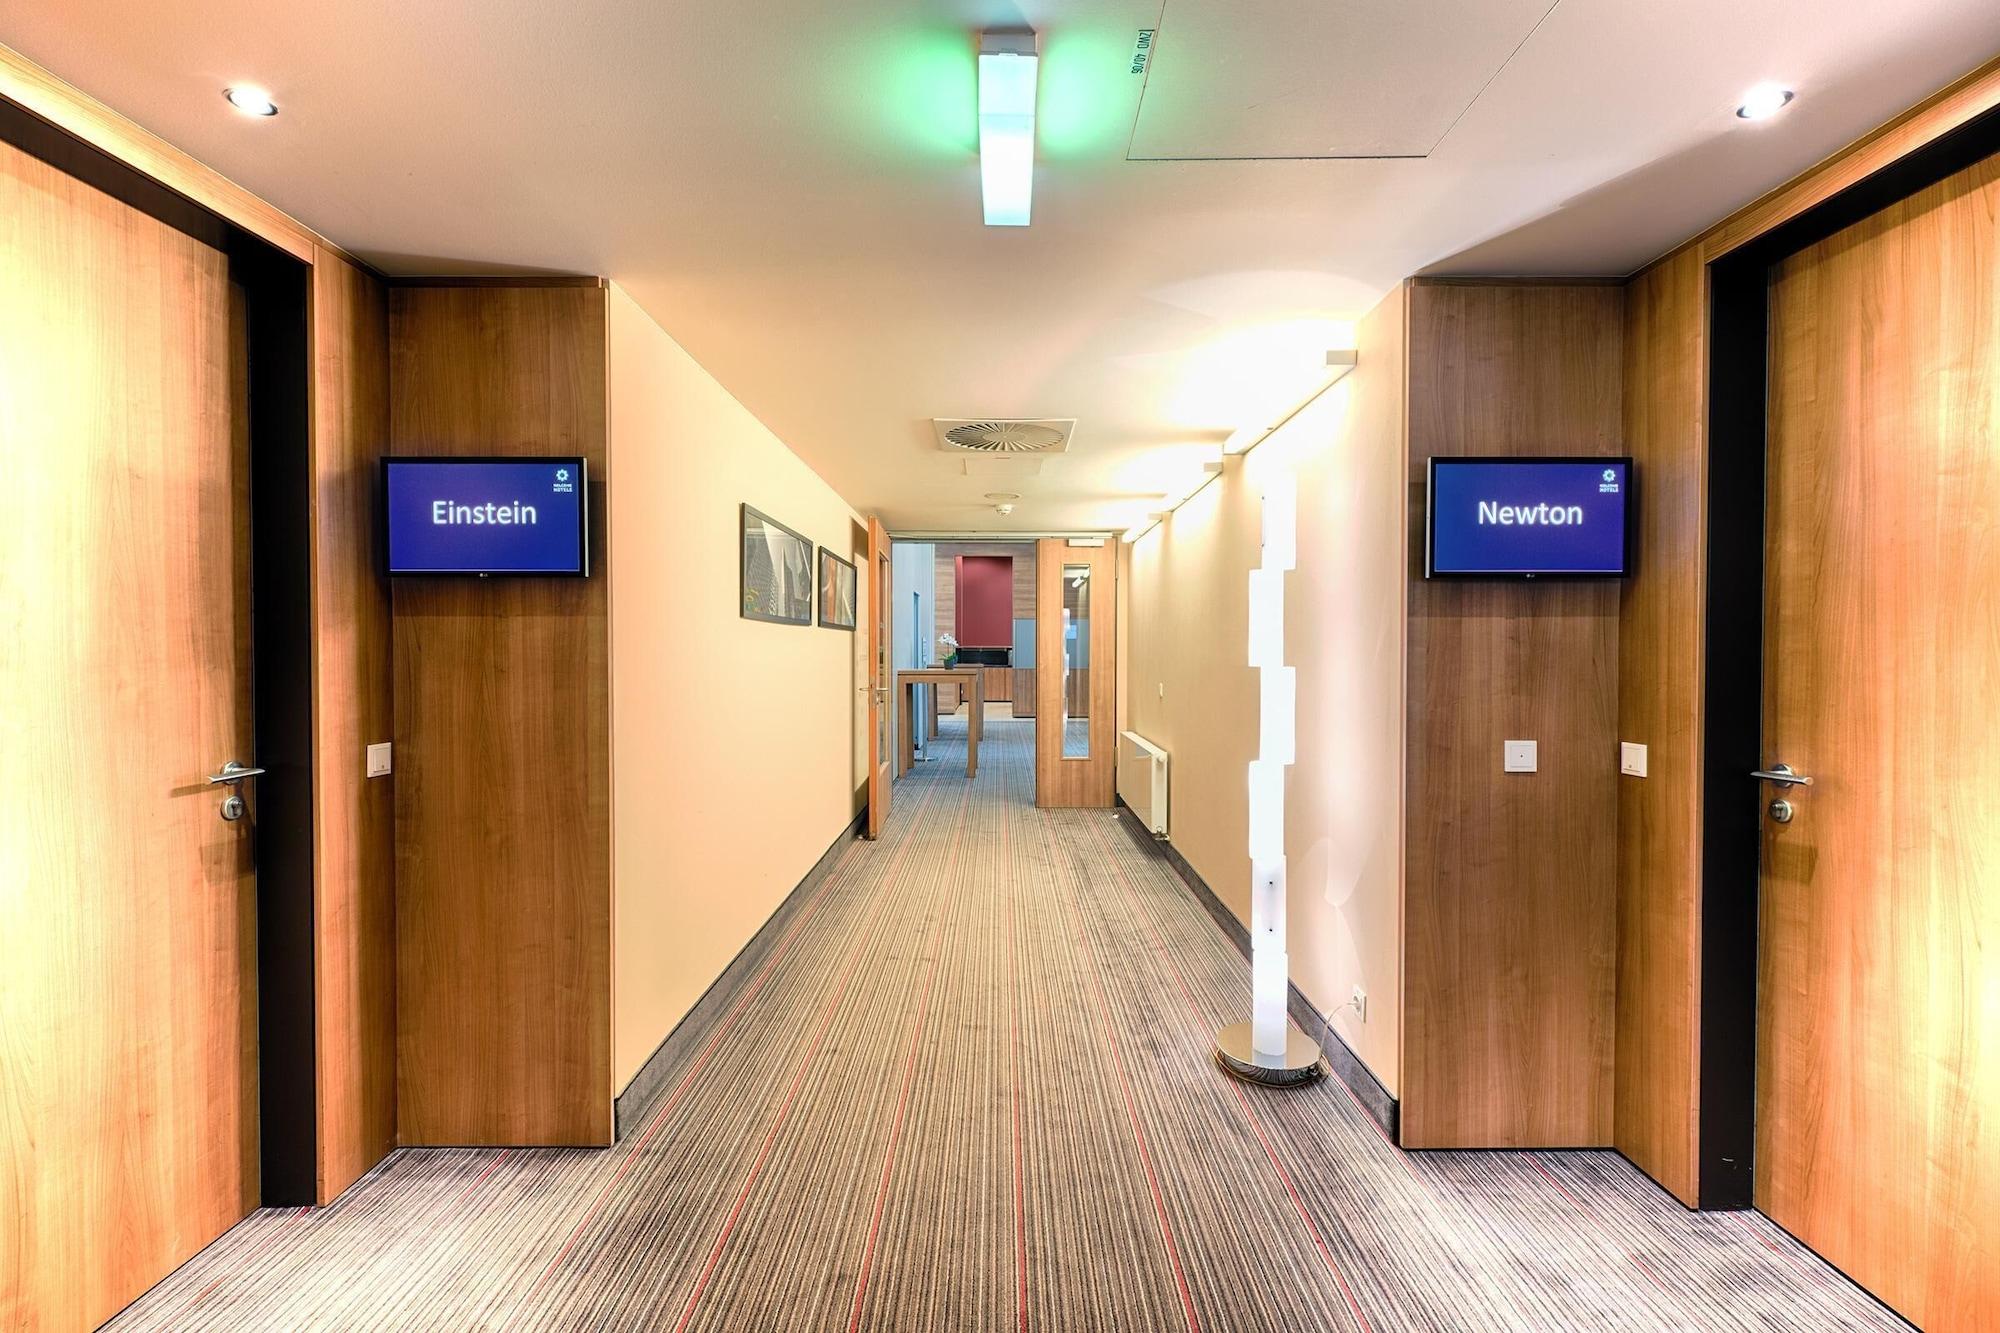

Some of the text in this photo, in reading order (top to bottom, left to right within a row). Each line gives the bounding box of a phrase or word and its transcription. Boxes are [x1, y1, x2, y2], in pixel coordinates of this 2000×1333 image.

[1137, 32, 1152, 49] ZWD
[432, 500, 537, 525] Einstein
[1478, 500, 1583, 525] Newton
